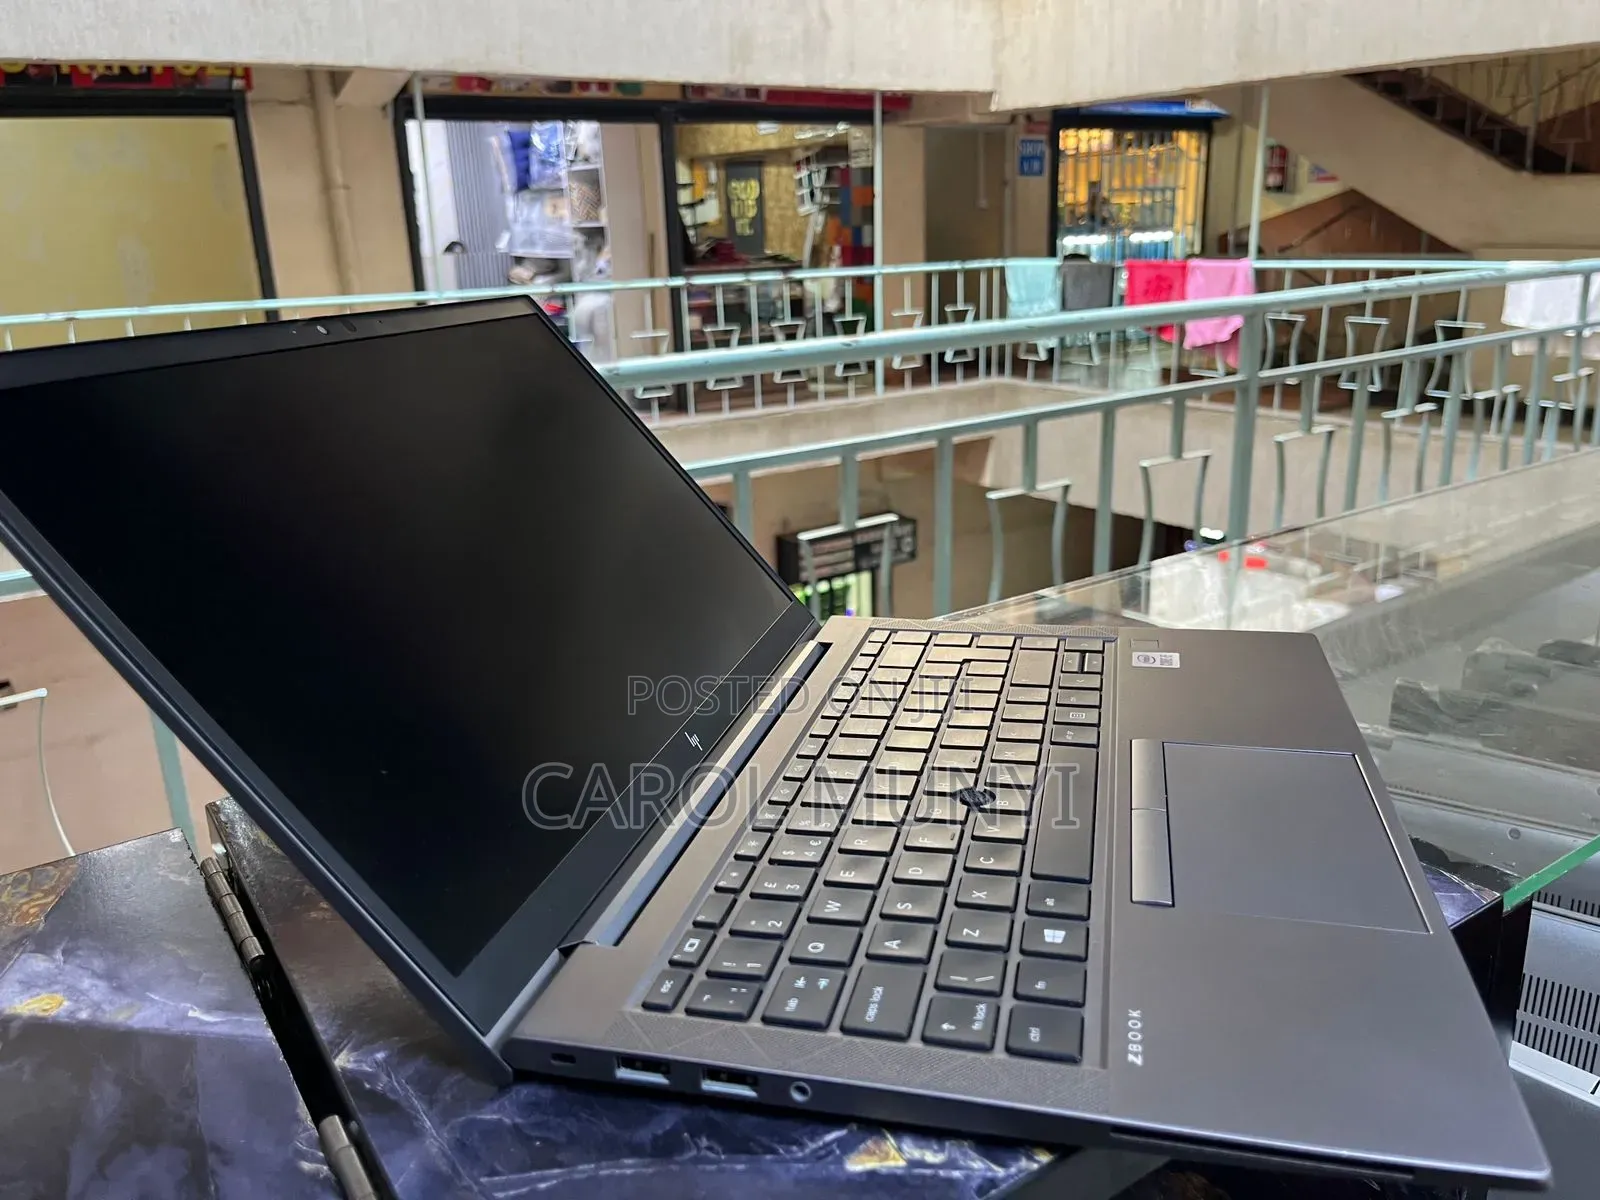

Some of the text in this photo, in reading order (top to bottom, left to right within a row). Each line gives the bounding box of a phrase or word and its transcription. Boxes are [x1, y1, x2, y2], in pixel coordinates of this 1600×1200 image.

[854, 838, 869, 846] R
[919, 836, 932, 844] F
[979, 856, 995, 865] C
[839, 870, 855, 878] E
[908, 867, 924, 875] D
[971, 889, 988, 899] X
[824, 900, 842, 913] W
[896, 902, 913, 910] S
[767, 919, 783, 928] 2
[962, 927, 980, 938] Z
[807, 941, 825, 954] Q
[884, 939, 902, 950] A
[659, 979, 674, 994] esc
[864, 985, 885, 1023] caps lock
[973, 1002, 988, 1020] lock
[1028, 1026, 1041, 1043] ctrl
[1126, 1008, 1144, 1067] ZBOOK
